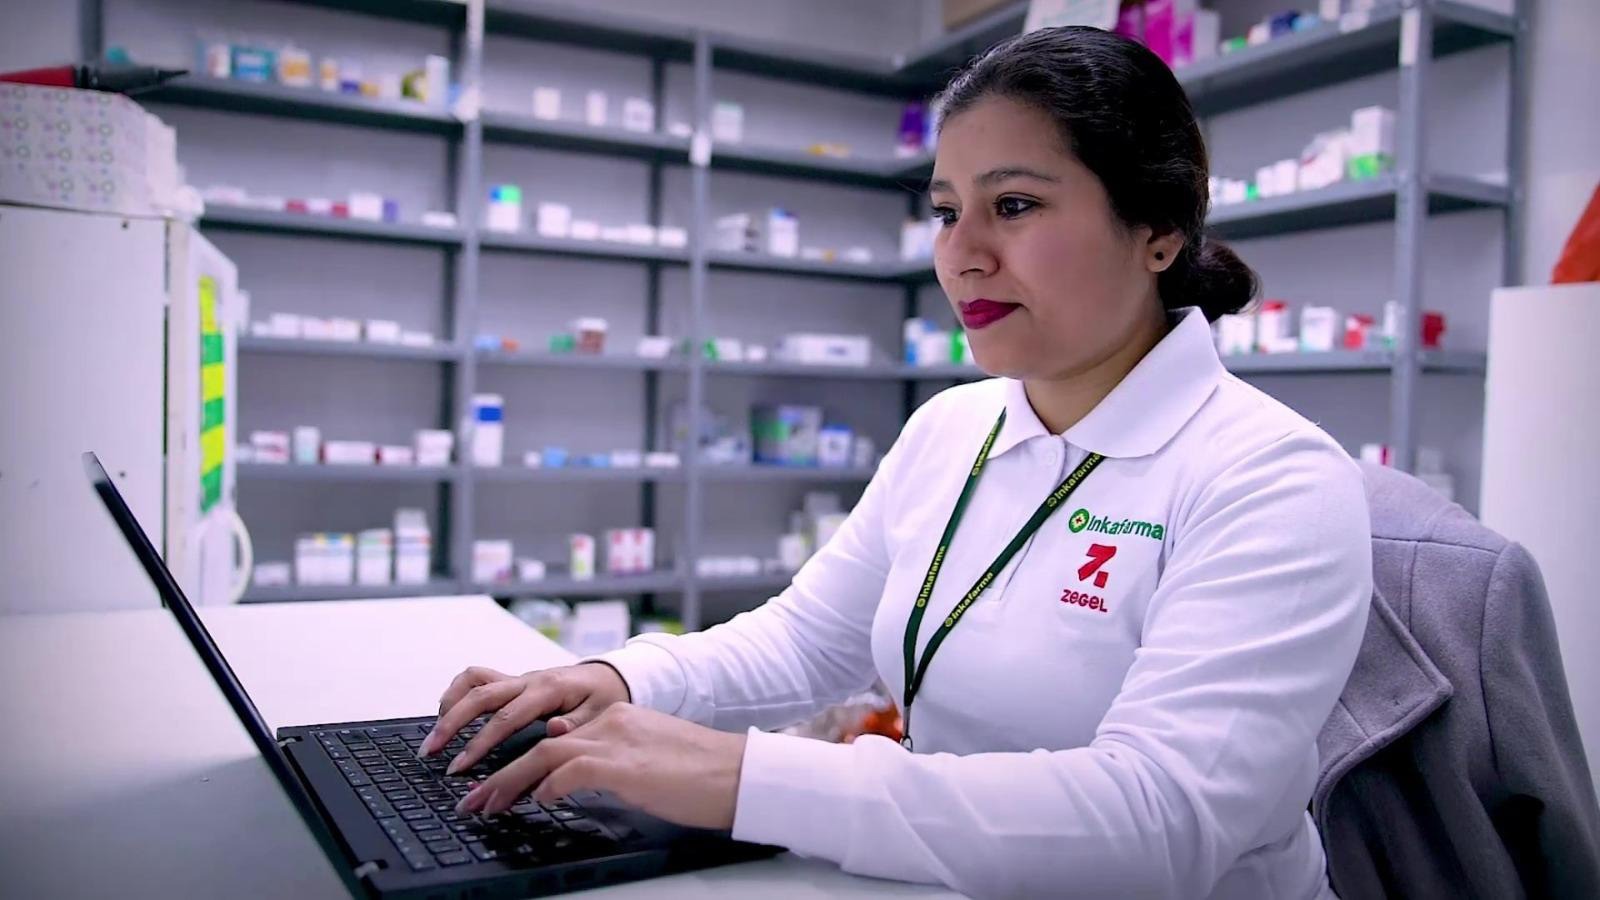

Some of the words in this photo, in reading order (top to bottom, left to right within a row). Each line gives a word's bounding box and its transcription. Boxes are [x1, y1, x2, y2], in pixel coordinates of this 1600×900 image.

[1054, 453, 1100, 499] Inkafarma
[1086, 515, 1164, 540] Inkafarma
[919, 545, 946, 598] Inkafarma
[951, 572, 994, 619] Inkafarma
